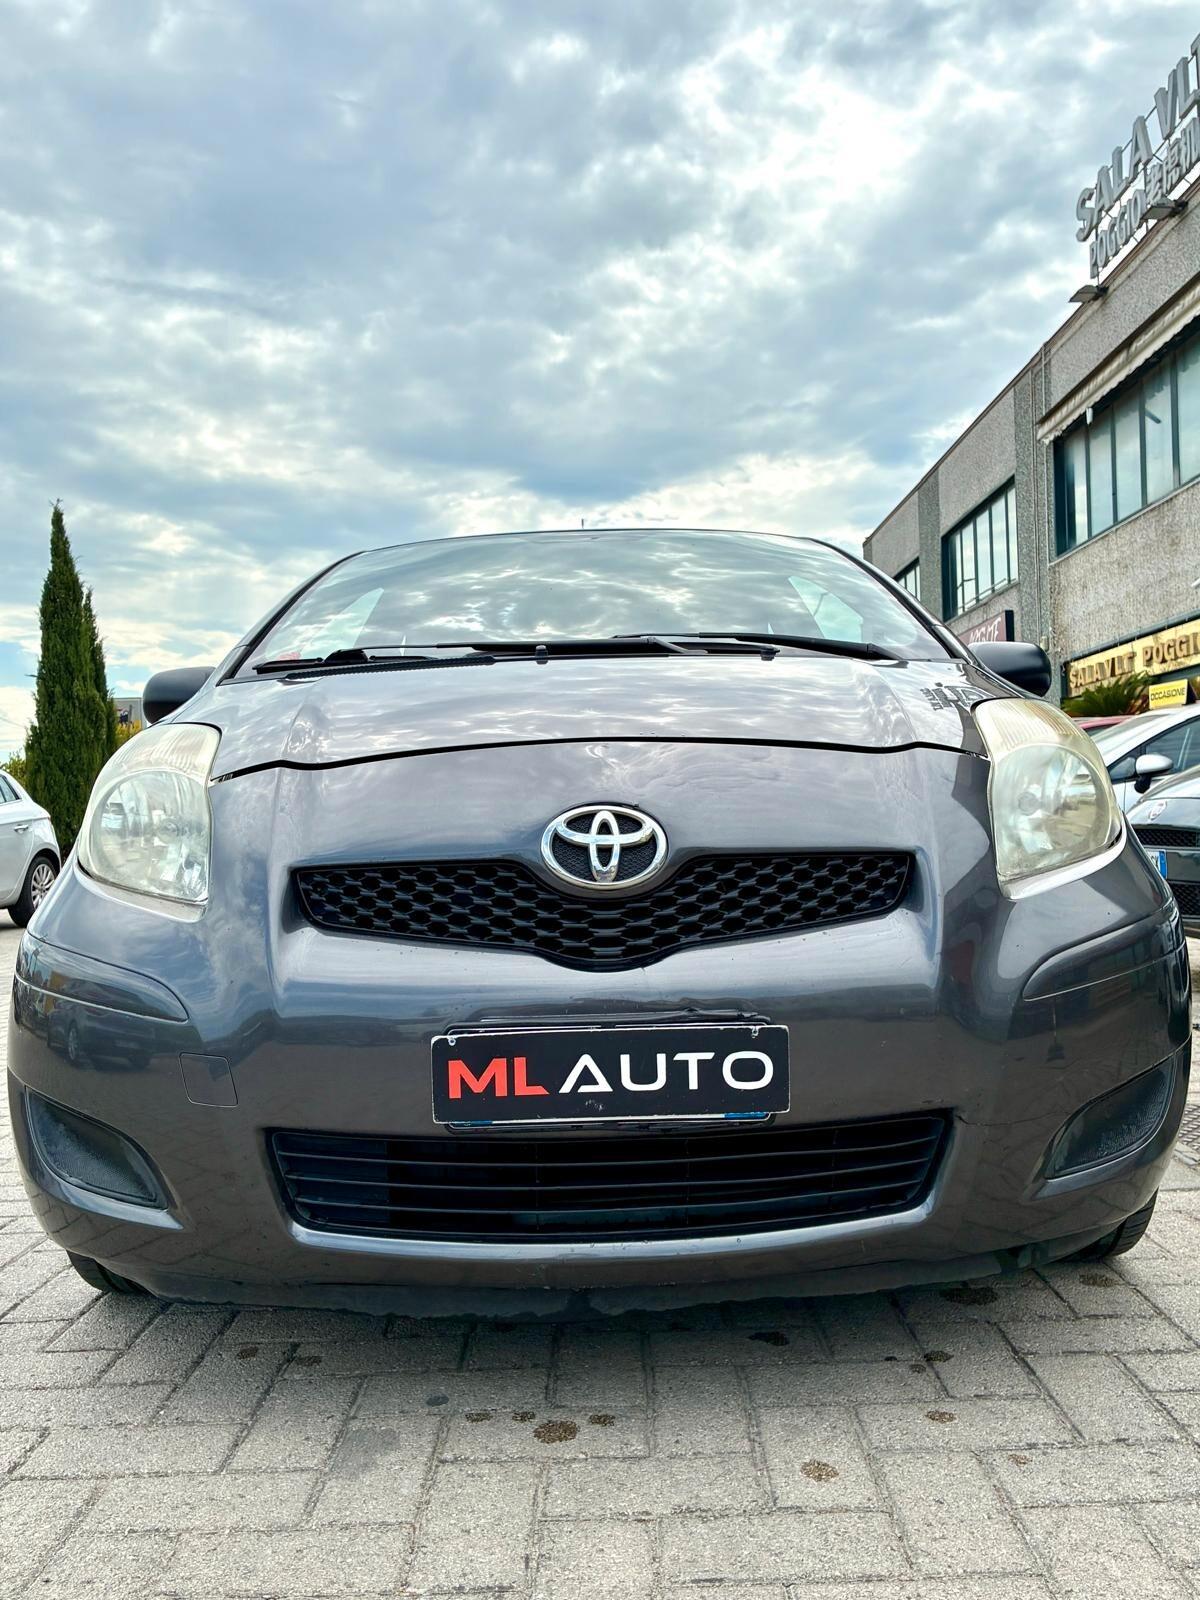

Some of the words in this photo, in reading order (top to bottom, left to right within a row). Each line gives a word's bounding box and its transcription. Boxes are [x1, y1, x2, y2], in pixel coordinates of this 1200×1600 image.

[1076, 115, 1153, 242] SALA
[1089, 189, 1147, 280] POGGIO
[1069, 662, 1105, 689] SALA
[1142, 631, 1200, 668] POGGI
[1150, 687, 1186, 701] OCCASIONE
[448, 1056, 550, 1099] ML
[558, 1050, 775, 1095] AUTO
